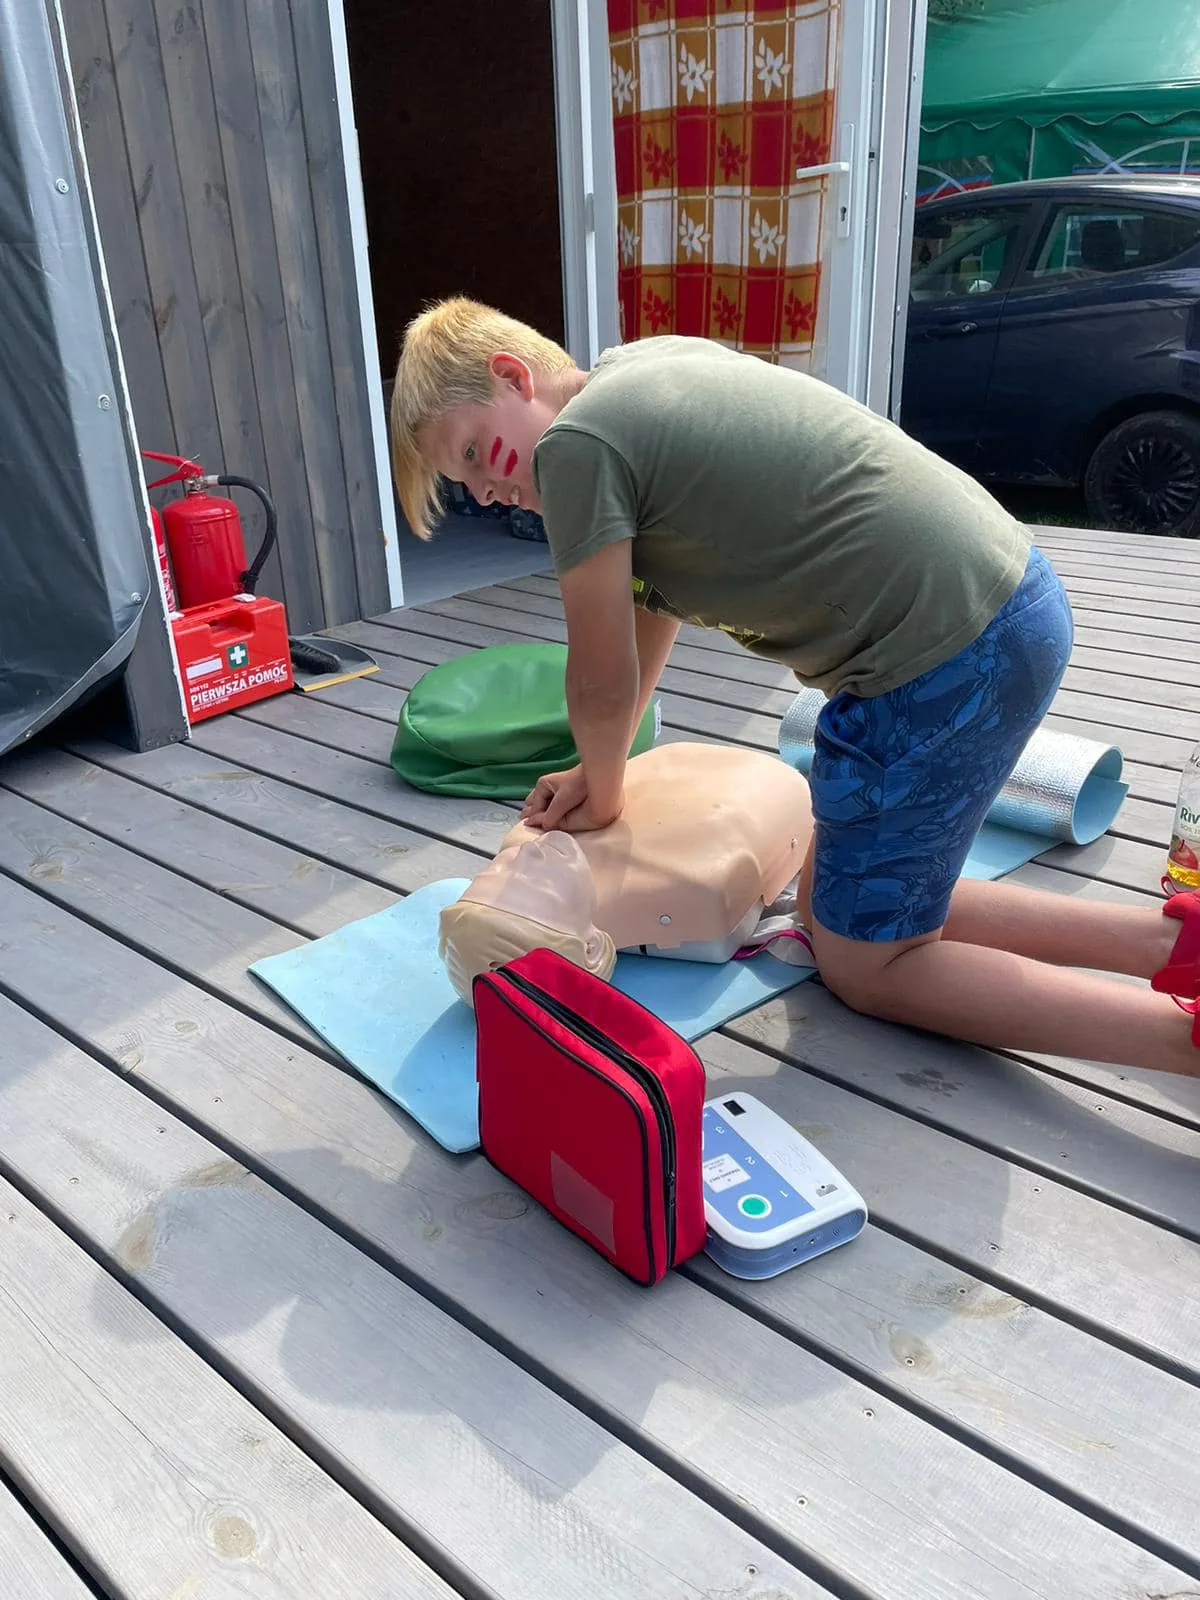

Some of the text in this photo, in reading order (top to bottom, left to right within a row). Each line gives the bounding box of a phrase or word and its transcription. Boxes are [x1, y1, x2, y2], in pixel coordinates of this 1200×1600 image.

[190, 679, 247, 706] PIERWSZA
[248, 664, 288, 687] POMOC
[745, 1156, 756, 1165] 2
[780, 1190, 789, 1198] 1
